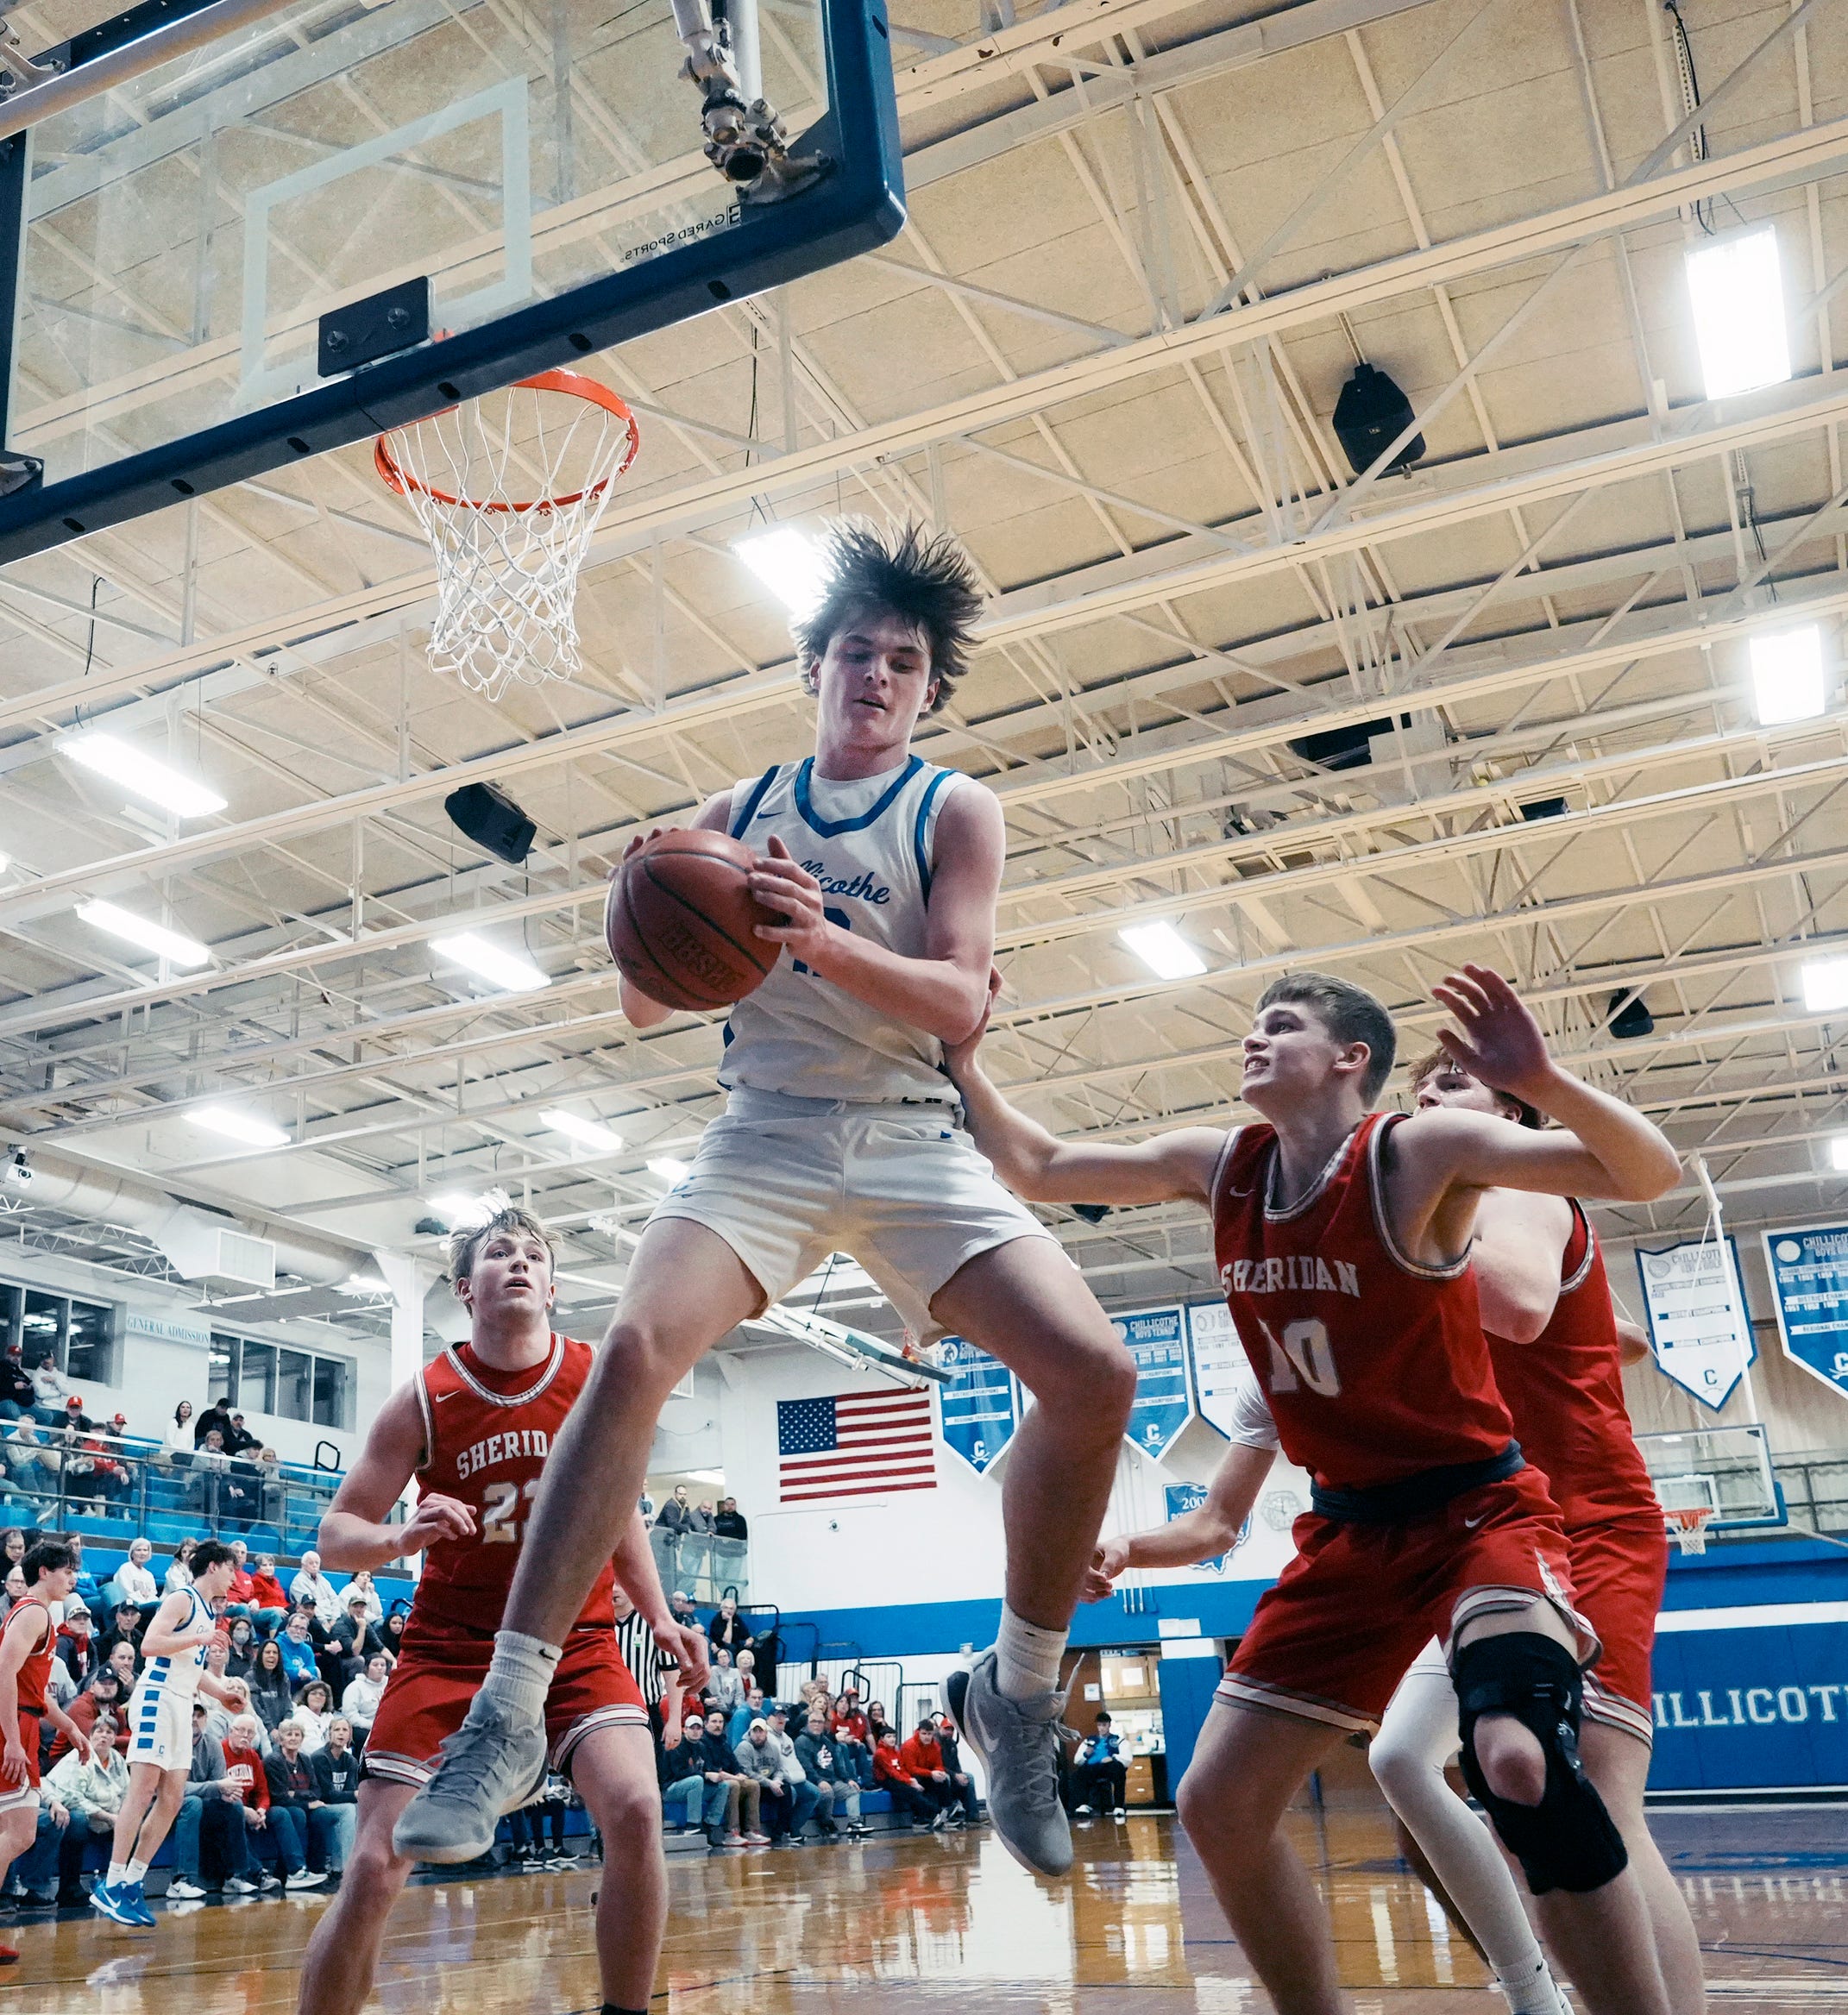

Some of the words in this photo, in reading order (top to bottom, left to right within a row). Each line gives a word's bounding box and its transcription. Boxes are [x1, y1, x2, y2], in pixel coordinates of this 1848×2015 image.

[1221, 1255, 1361, 1298] SHERIDAN
[128, 1316, 164, 1335] GENERAL
[168, 1325, 210, 1344] ADMISSION
[1129, 1315, 1179, 1332] CHILLICOTHE
[1256, 1317, 1342, 1397] 10
[1833, 1353, 1848, 1372] C
[1705, 1369, 1718, 1384] C
[1146, 1423, 1160, 1440] C
[456, 1429, 556, 1480] SHERID
[974, 1440, 984, 1458] C
[1651, 1685, 1848, 1728] ILLICOT
